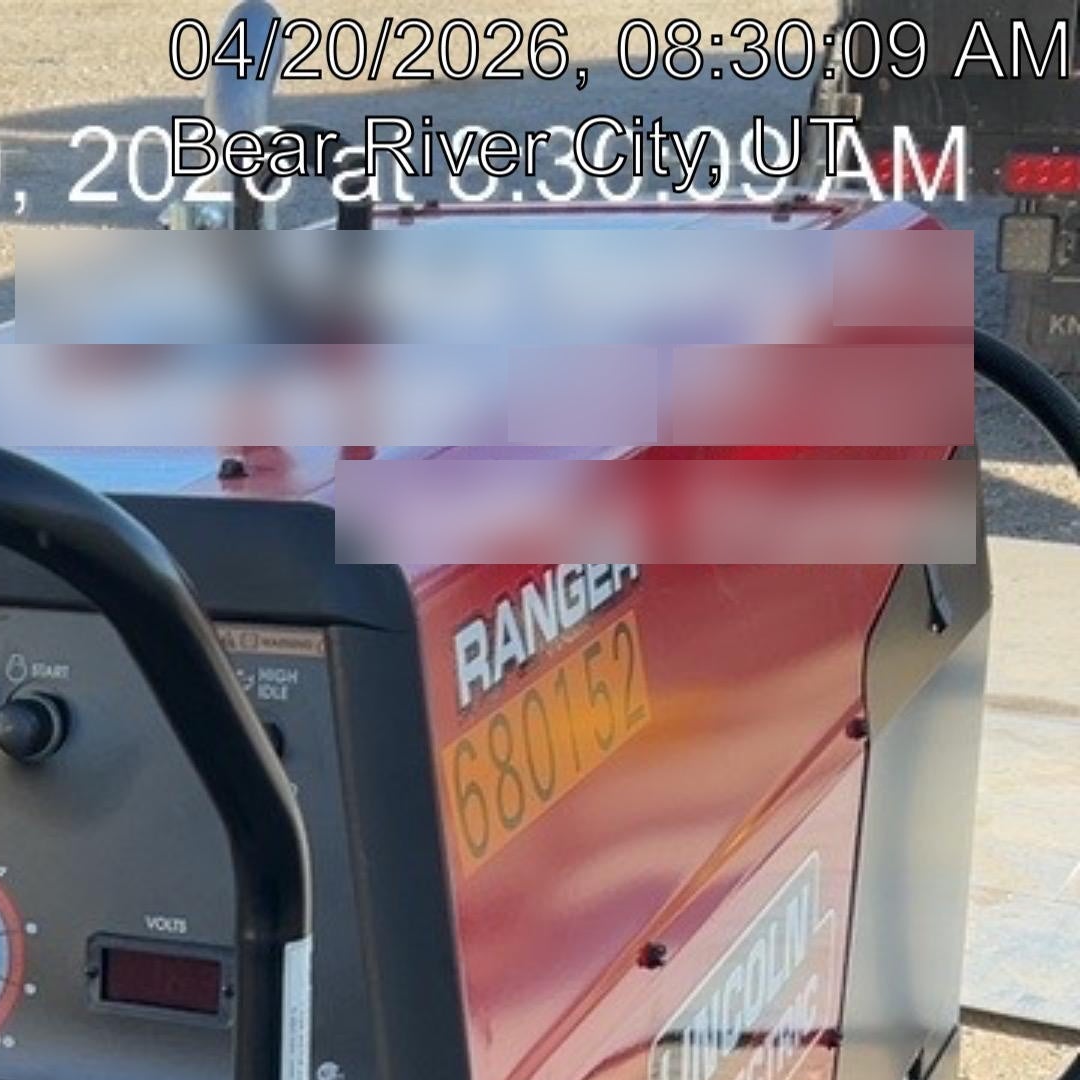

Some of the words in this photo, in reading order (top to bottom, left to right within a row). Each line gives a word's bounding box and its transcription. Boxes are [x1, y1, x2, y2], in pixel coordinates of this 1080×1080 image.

[31, 662, 70, 679] START
[452, 621, 648, 859] 680152
[143, 913, 188, 934] VOLTS
